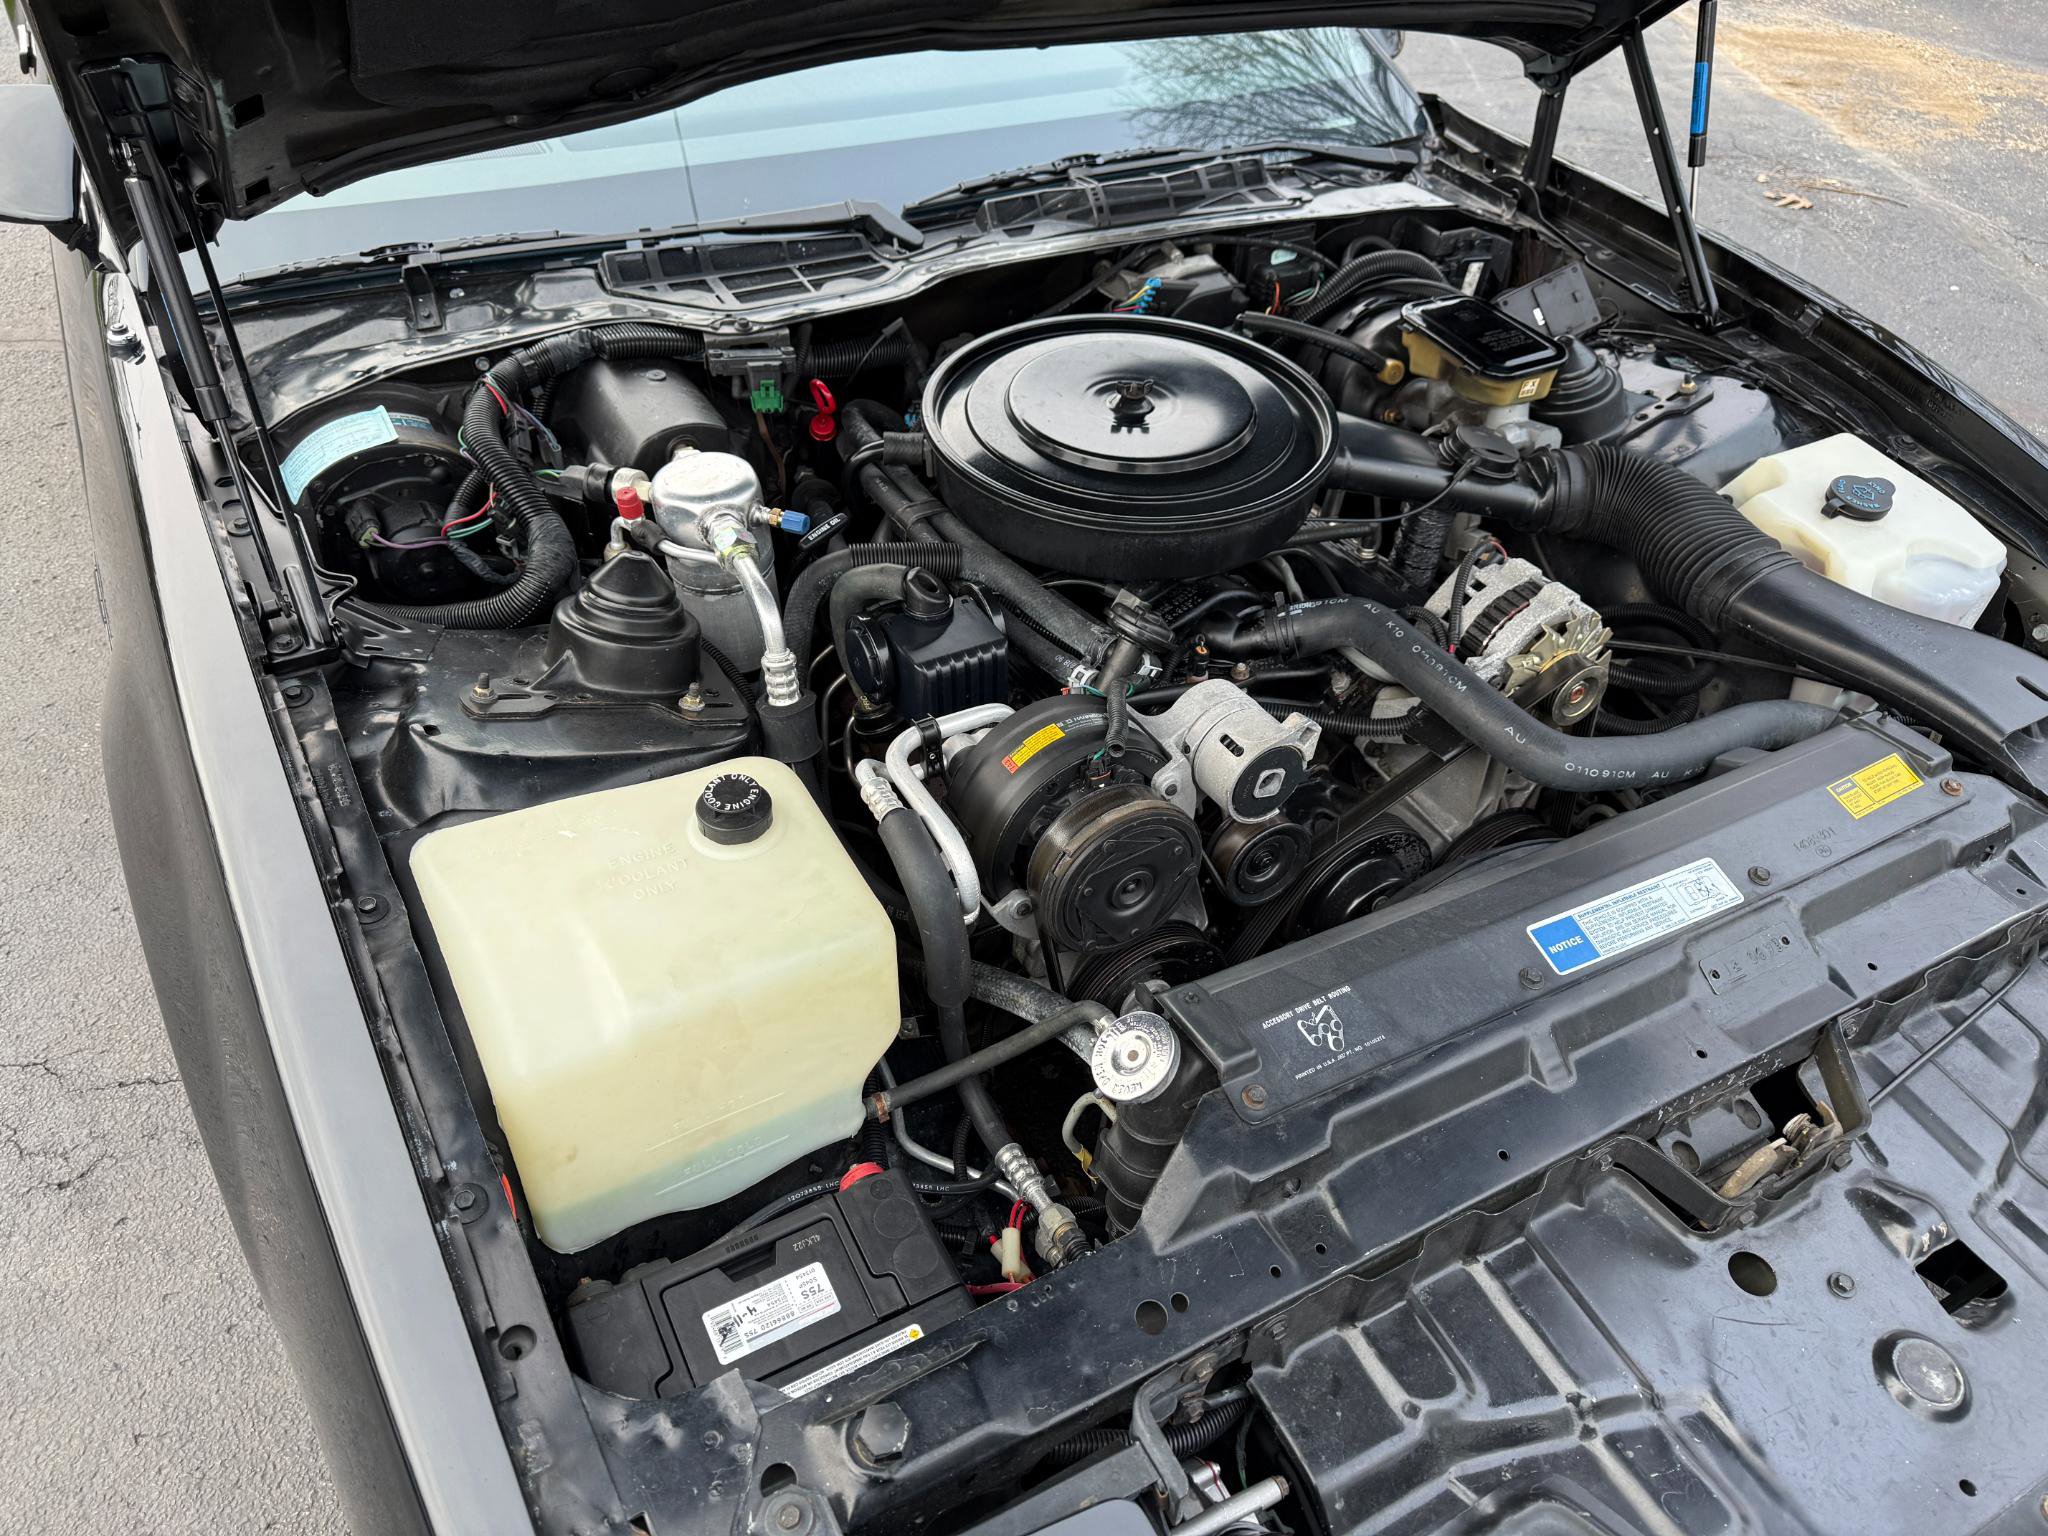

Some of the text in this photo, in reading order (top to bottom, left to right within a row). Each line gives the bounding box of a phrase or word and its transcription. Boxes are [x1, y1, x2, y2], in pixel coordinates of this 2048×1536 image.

[808, 524, 830, 540] ENGINE
[1364, 603, 1380, 614] AU
[1386, 620, 1404, 638] K10
[1504, 726, 1526, 744] AU
[1565, 762, 1636, 778] 011091CM
[731, 773, 757, 786] ONLY
[724, 788, 758, 810] ENGINE
[1548, 936, 1584, 954] NOTICE
[1261, 984, 1351, 1029] ACCESSORY DRIVE BELT ROUTING
[1294, 1066, 1315, 1080] PRINTED
[800, 1282, 824, 1300] 75S
